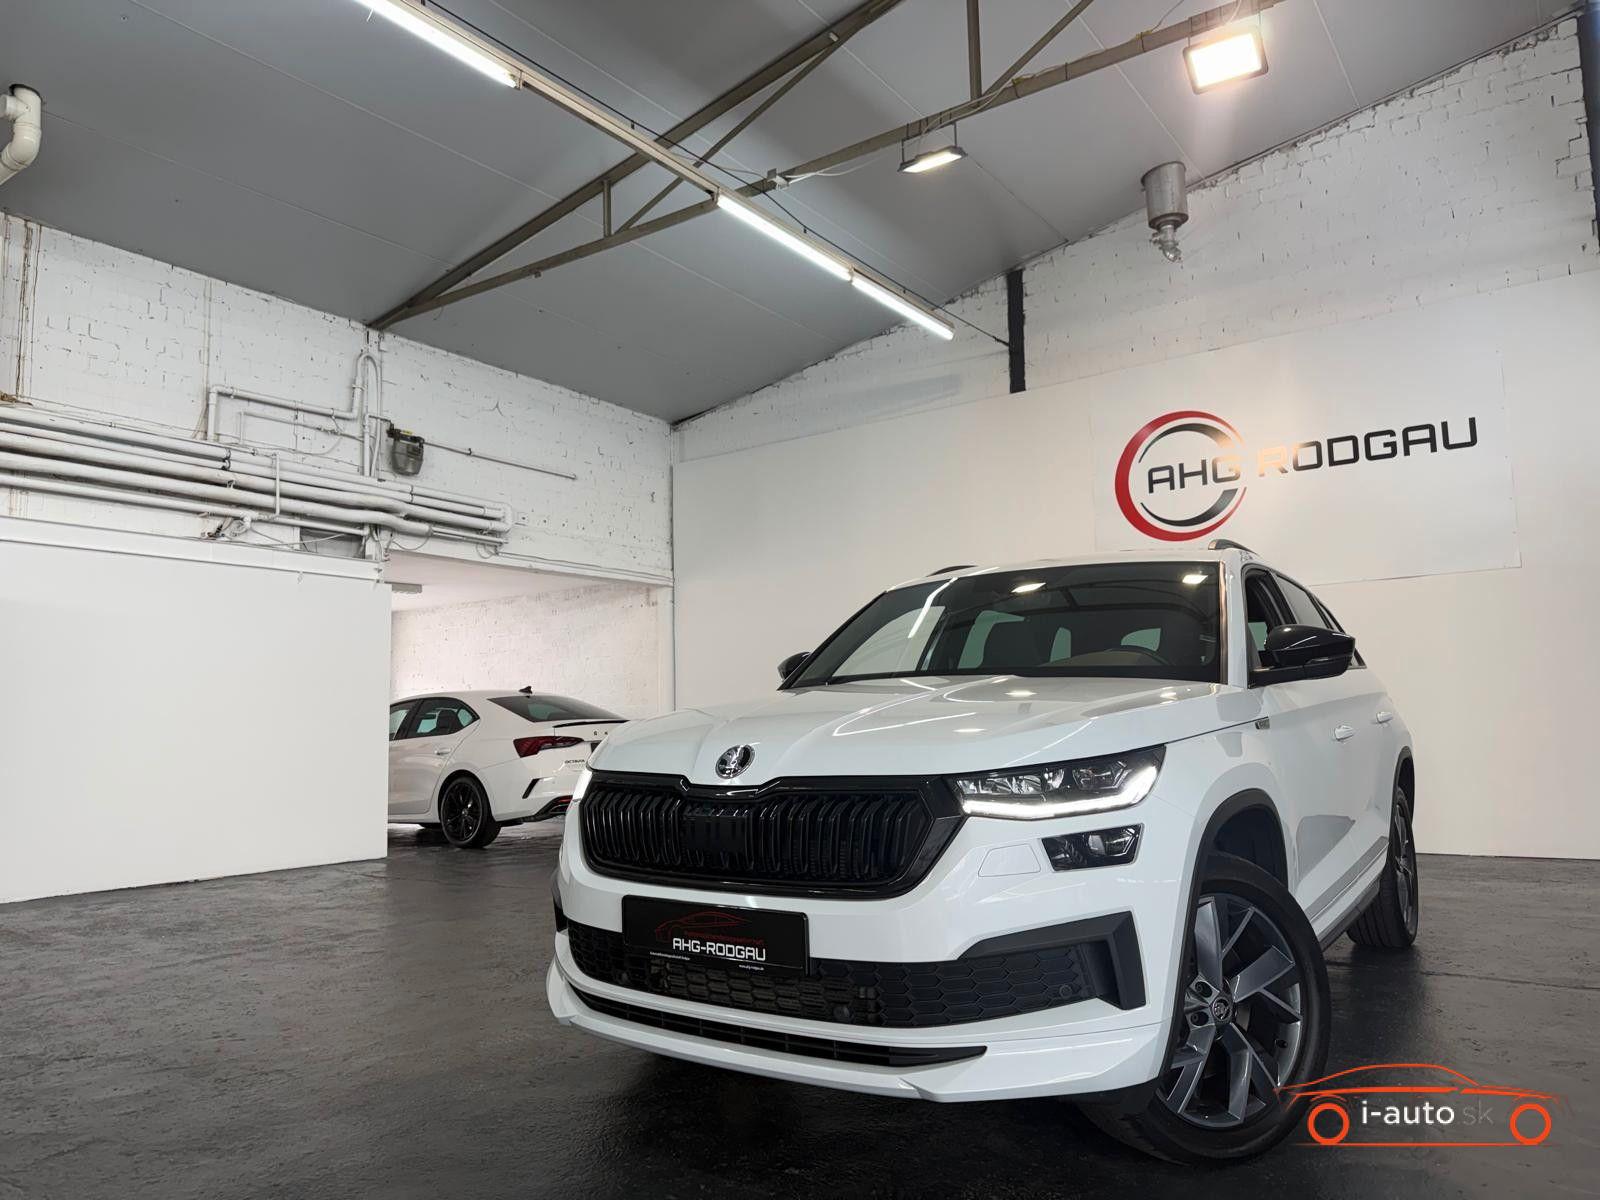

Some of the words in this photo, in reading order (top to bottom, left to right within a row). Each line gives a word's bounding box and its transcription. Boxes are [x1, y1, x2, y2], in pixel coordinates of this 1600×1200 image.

[1147, 457, 1241, 493] AHG
[1257, 416, 1478, 477] RODGAU
[672, 938, 766, 960] AHG-RODGAU
